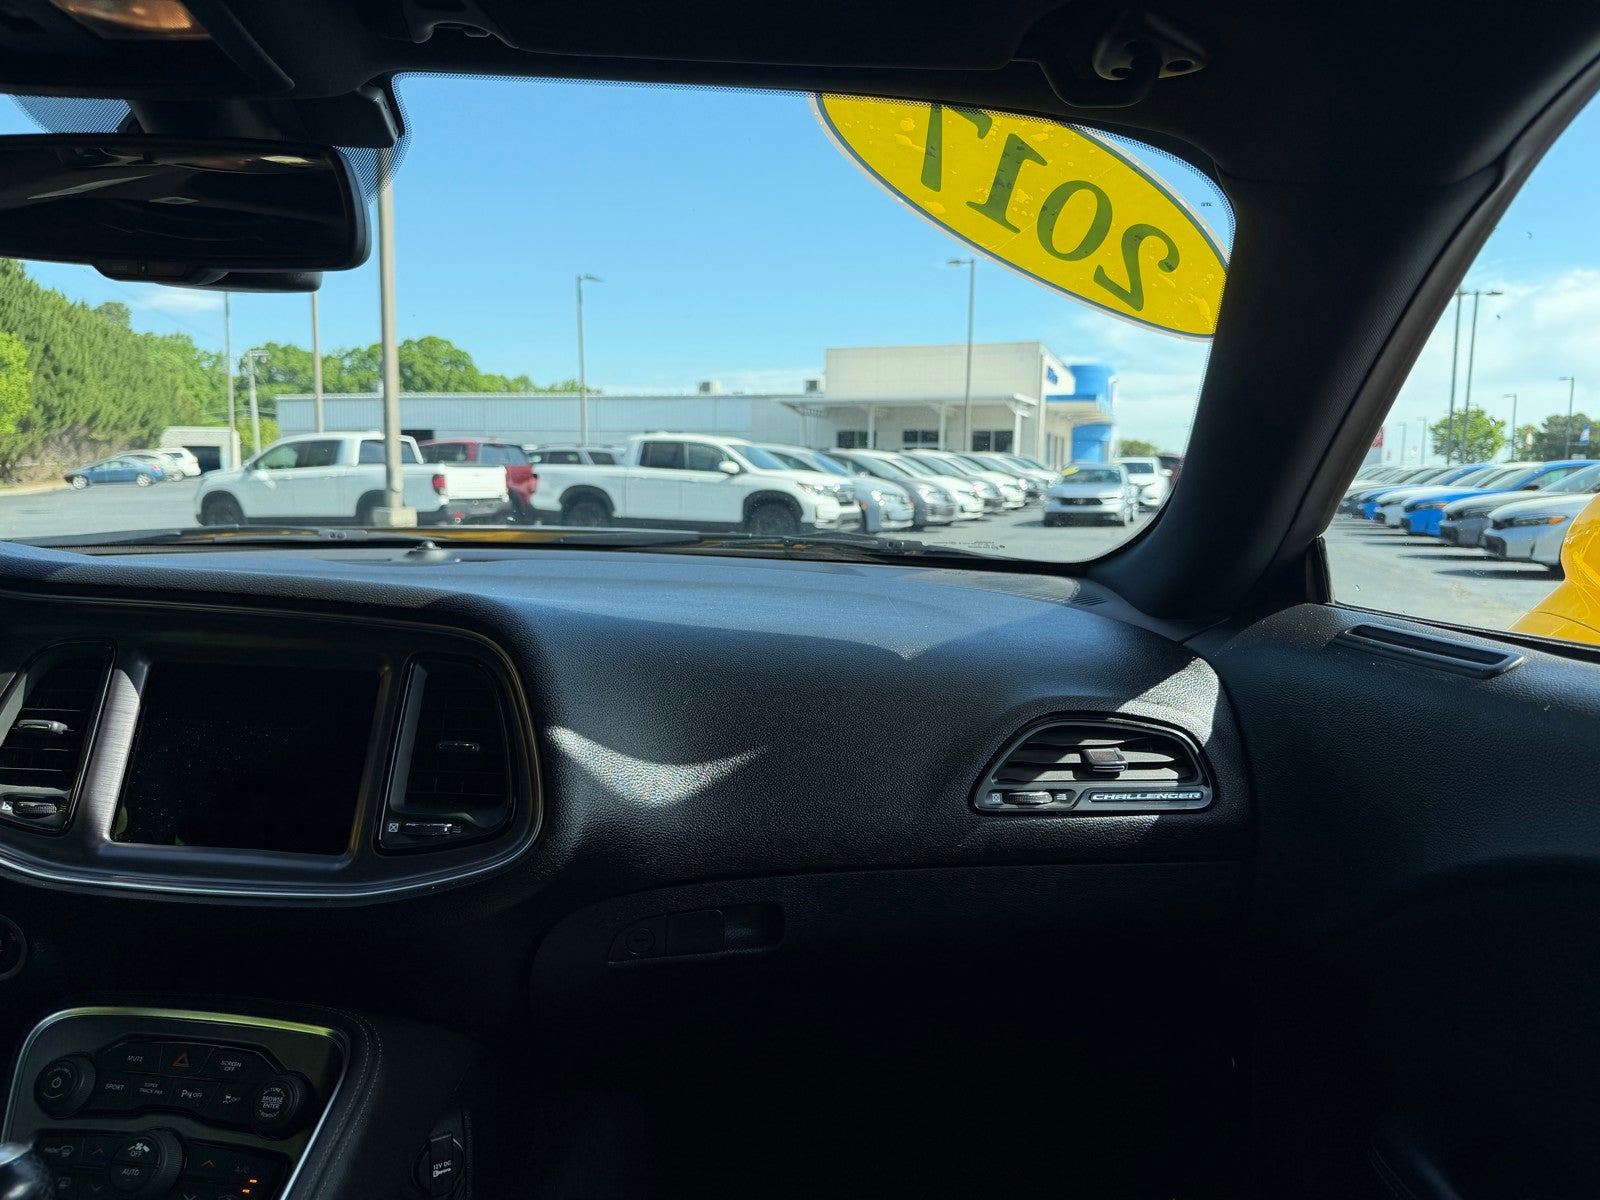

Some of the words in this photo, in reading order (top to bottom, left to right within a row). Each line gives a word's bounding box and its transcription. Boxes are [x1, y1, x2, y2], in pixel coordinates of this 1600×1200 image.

[1092, 791, 1201, 801] CHALLENGER
[127, 1055, 144, 1064] MUTE
[220, 1060, 242, 1068] SCREEN
[104, 1082, 125, 1092] SPORT
[121, 1168, 140, 1177] AUTO
